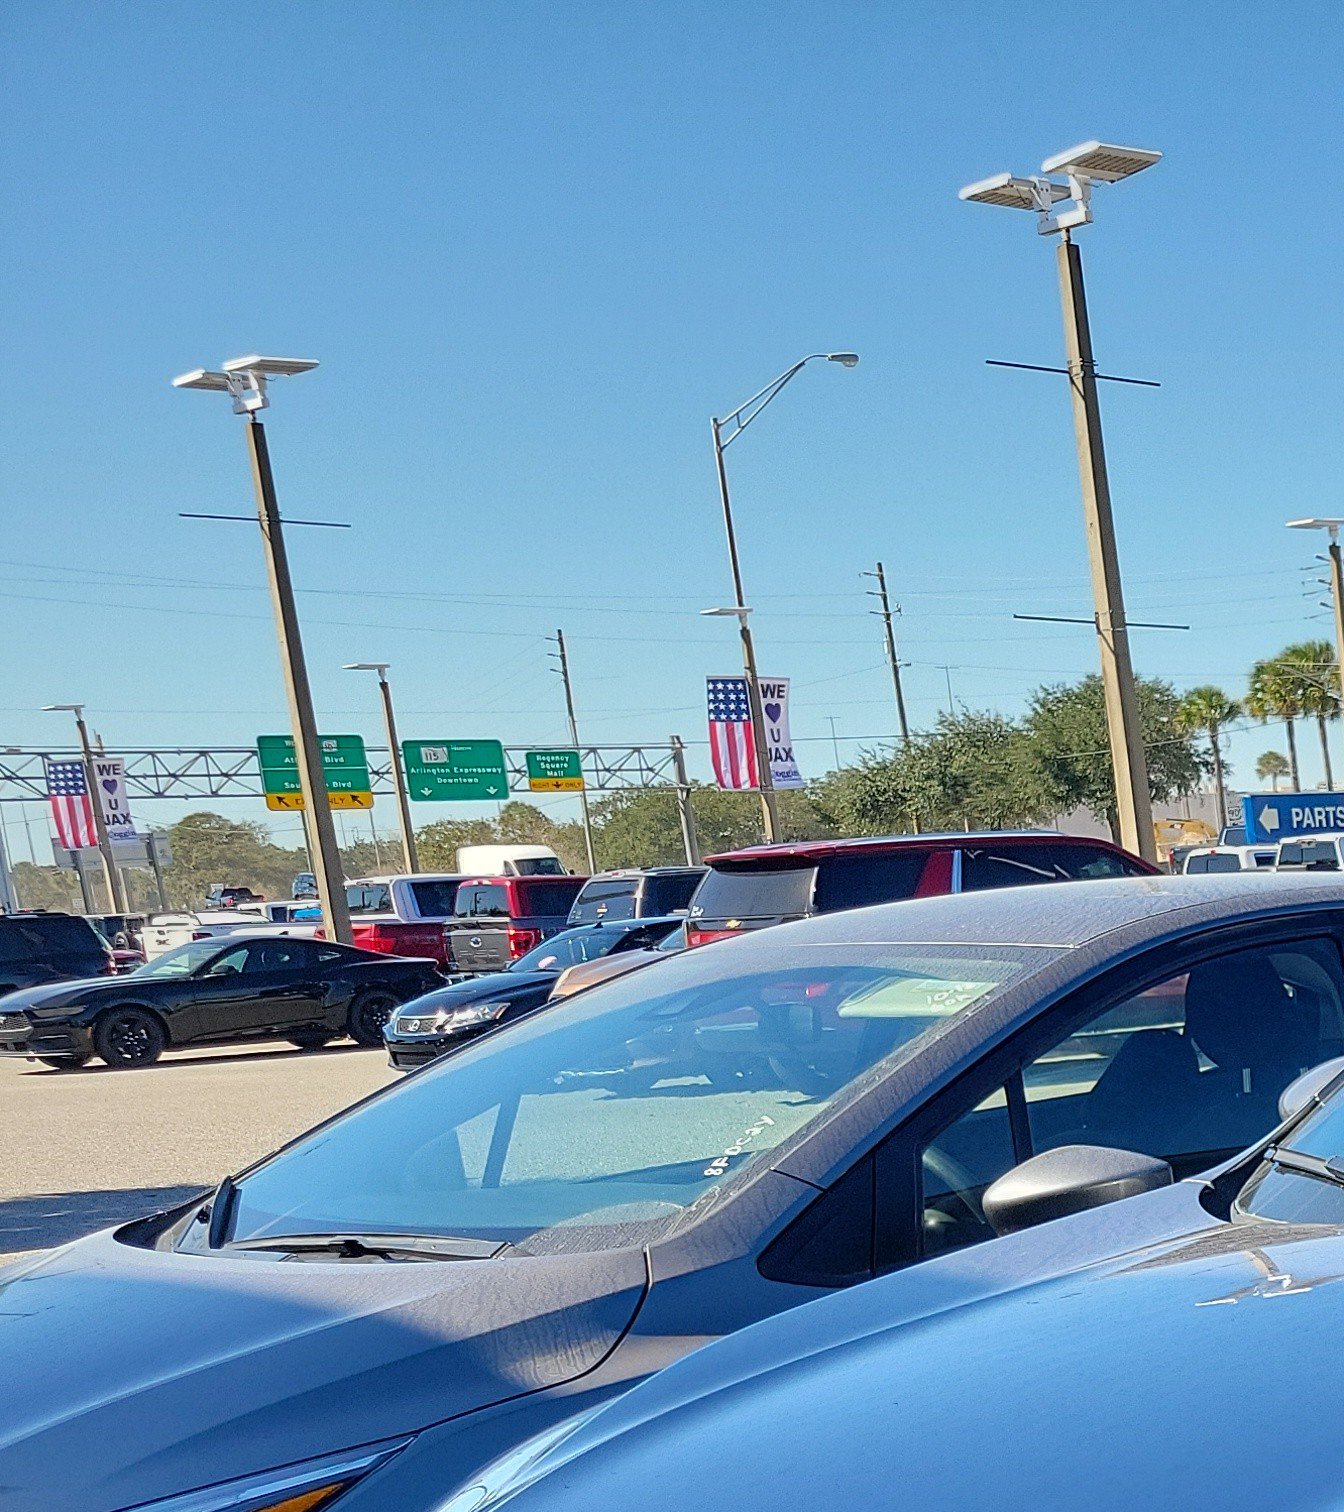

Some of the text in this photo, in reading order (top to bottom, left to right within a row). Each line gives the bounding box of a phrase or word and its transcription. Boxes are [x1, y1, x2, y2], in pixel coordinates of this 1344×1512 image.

[761, 684, 786, 699] WE
[771, 728, 780, 743] U
[425, 752, 438, 760] 115
[536, 755, 569, 763] Regency
[97, 764, 121, 776] WE
[411, 766, 502, 775] Arlington Expressway
[540, 762, 569, 770] Square
[109, 799, 119, 810] U
[104, 814, 132, 826] JAX
